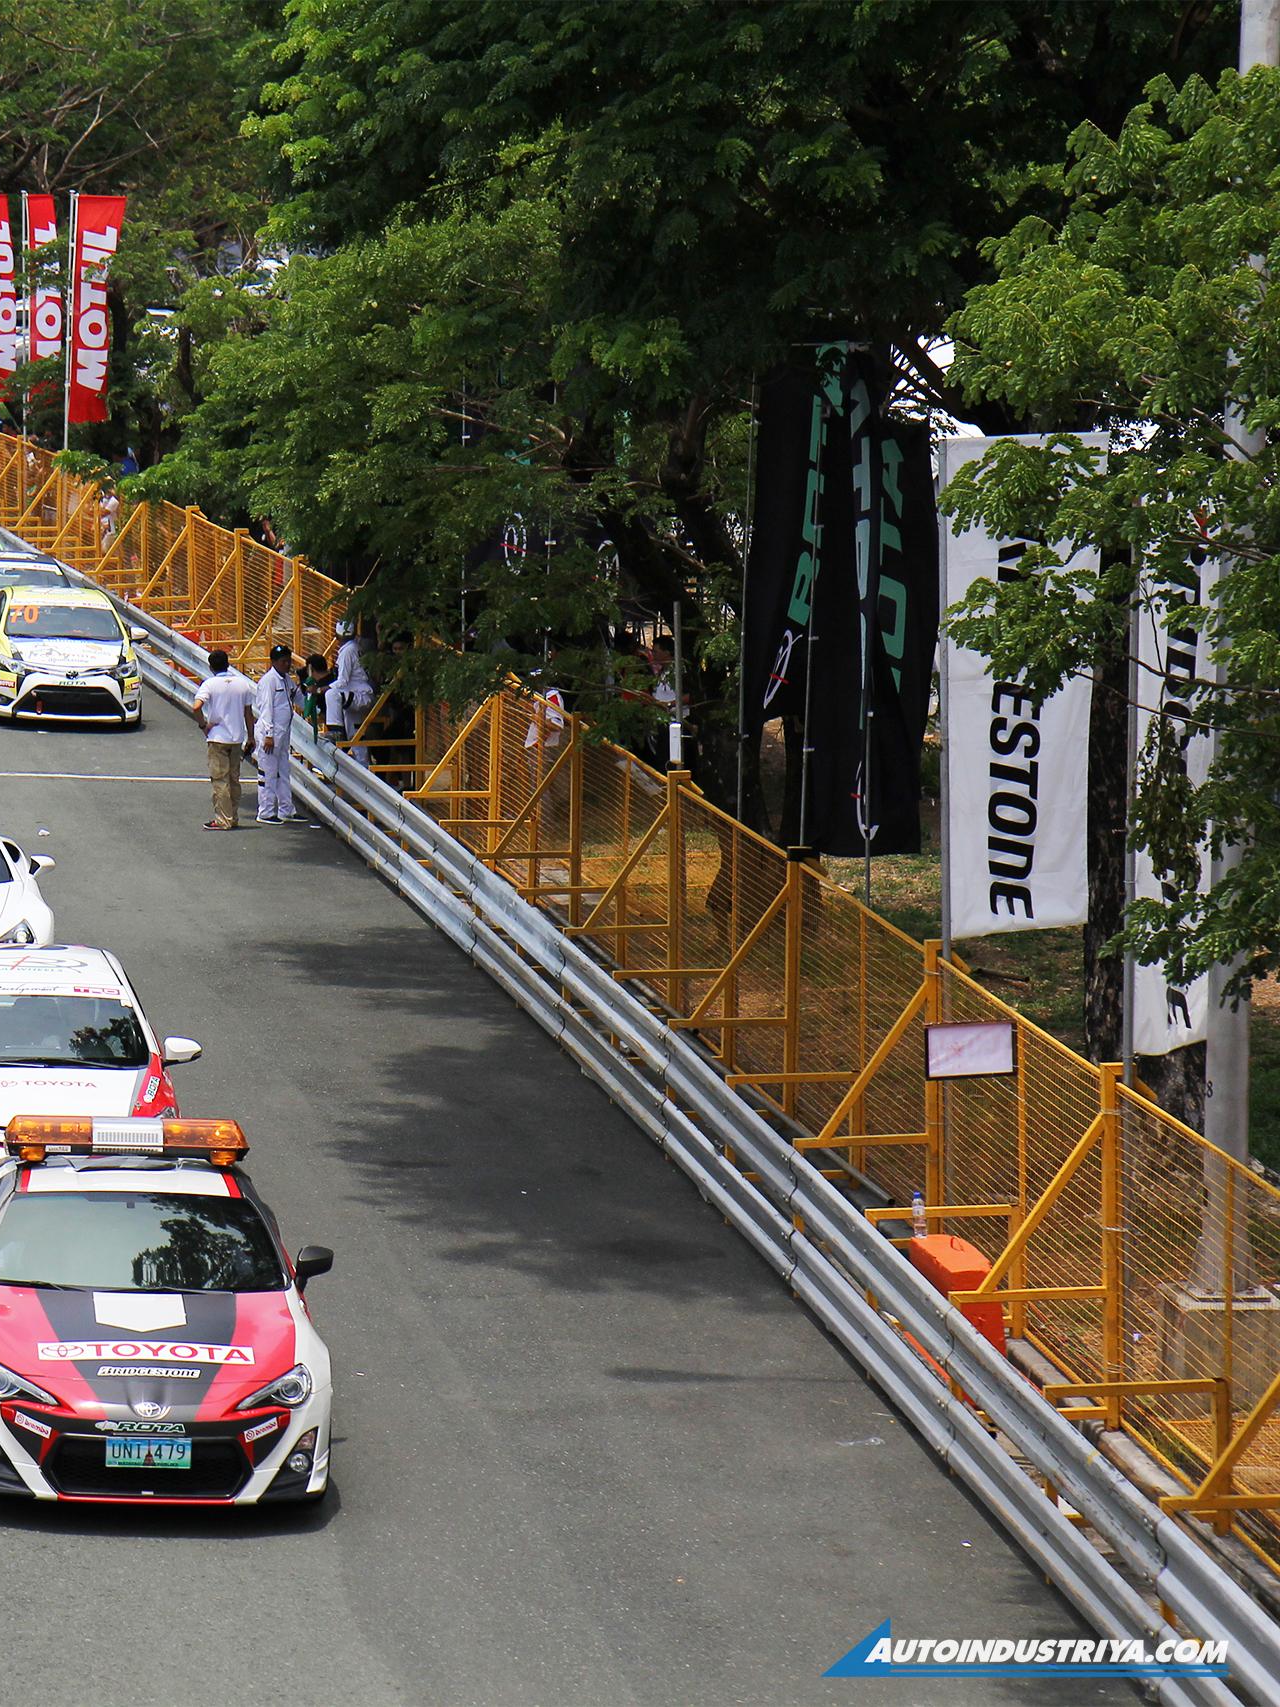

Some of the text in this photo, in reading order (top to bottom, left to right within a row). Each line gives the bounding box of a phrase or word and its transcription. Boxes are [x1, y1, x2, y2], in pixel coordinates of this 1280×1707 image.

[34, 221, 62, 359] OTL
[77, 226, 118, 391] MOTUL
[10, 605, 39, 624] 70
[25, 1080, 97, 1088] TOYOTA
[86, 1343, 252, 1362] TOYOTA
[99, 1367, 200, 1377] BRIDGESTONE
[24, 1418, 51, 1437] brembo
[115, 1421, 186, 1433] ROTA
[255, 1420, 278, 1436] brembo
[111, 1443, 186, 1460] UNI 479
